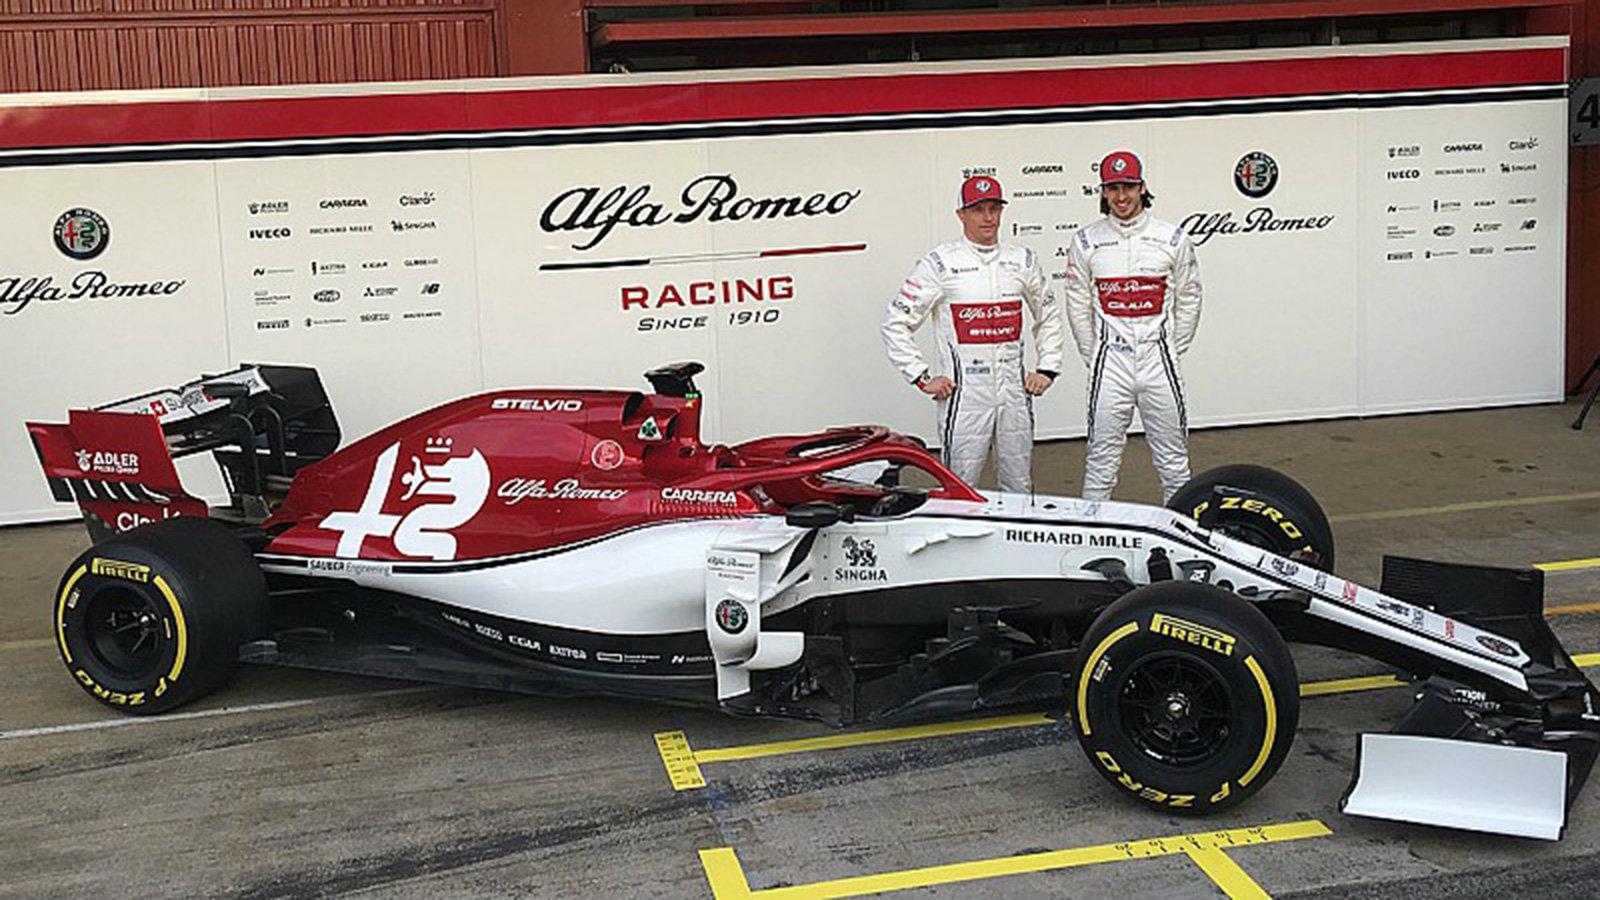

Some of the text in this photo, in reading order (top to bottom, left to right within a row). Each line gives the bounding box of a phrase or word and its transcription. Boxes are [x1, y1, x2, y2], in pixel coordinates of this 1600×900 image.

[1387, 169, 1420, 179] IVECO
[400, 194, 432, 206] Claro
[539, 174, 861, 250] Alfa Romeo
[1242, 207, 1335, 232] Romeo
[249, 228, 291, 239] IVECO
[68, 271, 186, 299] Romeo
[621, 276, 794, 311] RACING
[637, 309, 780, 331] SINCE 1910
[491, 397, 583, 412] STELVIO
[93, 451, 139, 467] ADLER
[497, 478, 628, 506] Alfa Romeo
[661, 486, 737, 503] CARRERA
[1219, 496, 1303, 540] ZERO
[1006, 529, 1143, 549] RICHARD MILLE
[91, 557, 150, 583] PIRELLI
[345, 562, 391, 577] Engineering
[835, 567, 888, 581] SINGHA
[1149, 612, 1237, 657] PIRELLI
[76, 669, 145, 706] ZERO
[1096, 751, 1196, 807] ZERO
